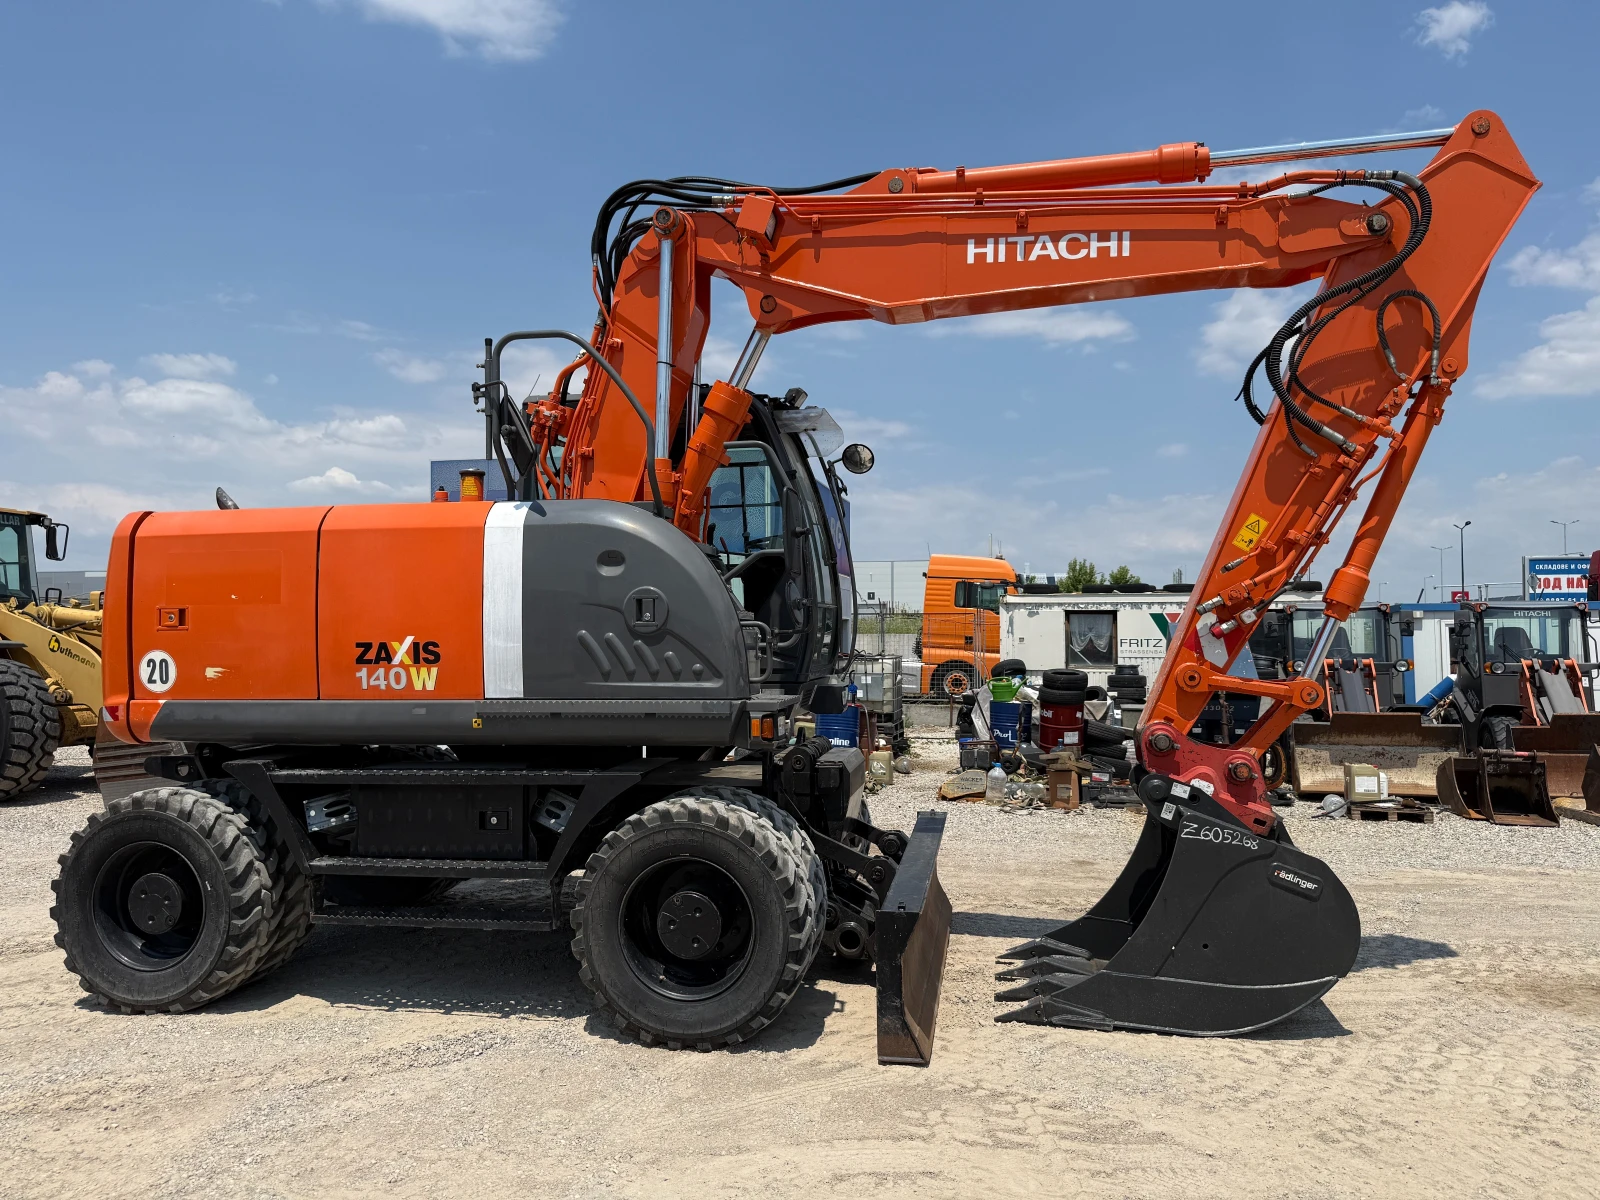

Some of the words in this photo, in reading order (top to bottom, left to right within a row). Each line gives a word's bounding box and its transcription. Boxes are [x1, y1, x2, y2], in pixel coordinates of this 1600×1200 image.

[966, 231, 1131, 264] HITACHI
[48, 635, 96, 670] huthmann
[355, 635, 441, 665] ZAXIS
[1119, 638, 1163, 648] FRITZ
[146, 658, 170, 685] 20
[1040, 708, 1054, 718] obil
[1180, 821, 1259, 849] Z605268
[1274, 870, 1318, 890] rädlinger
